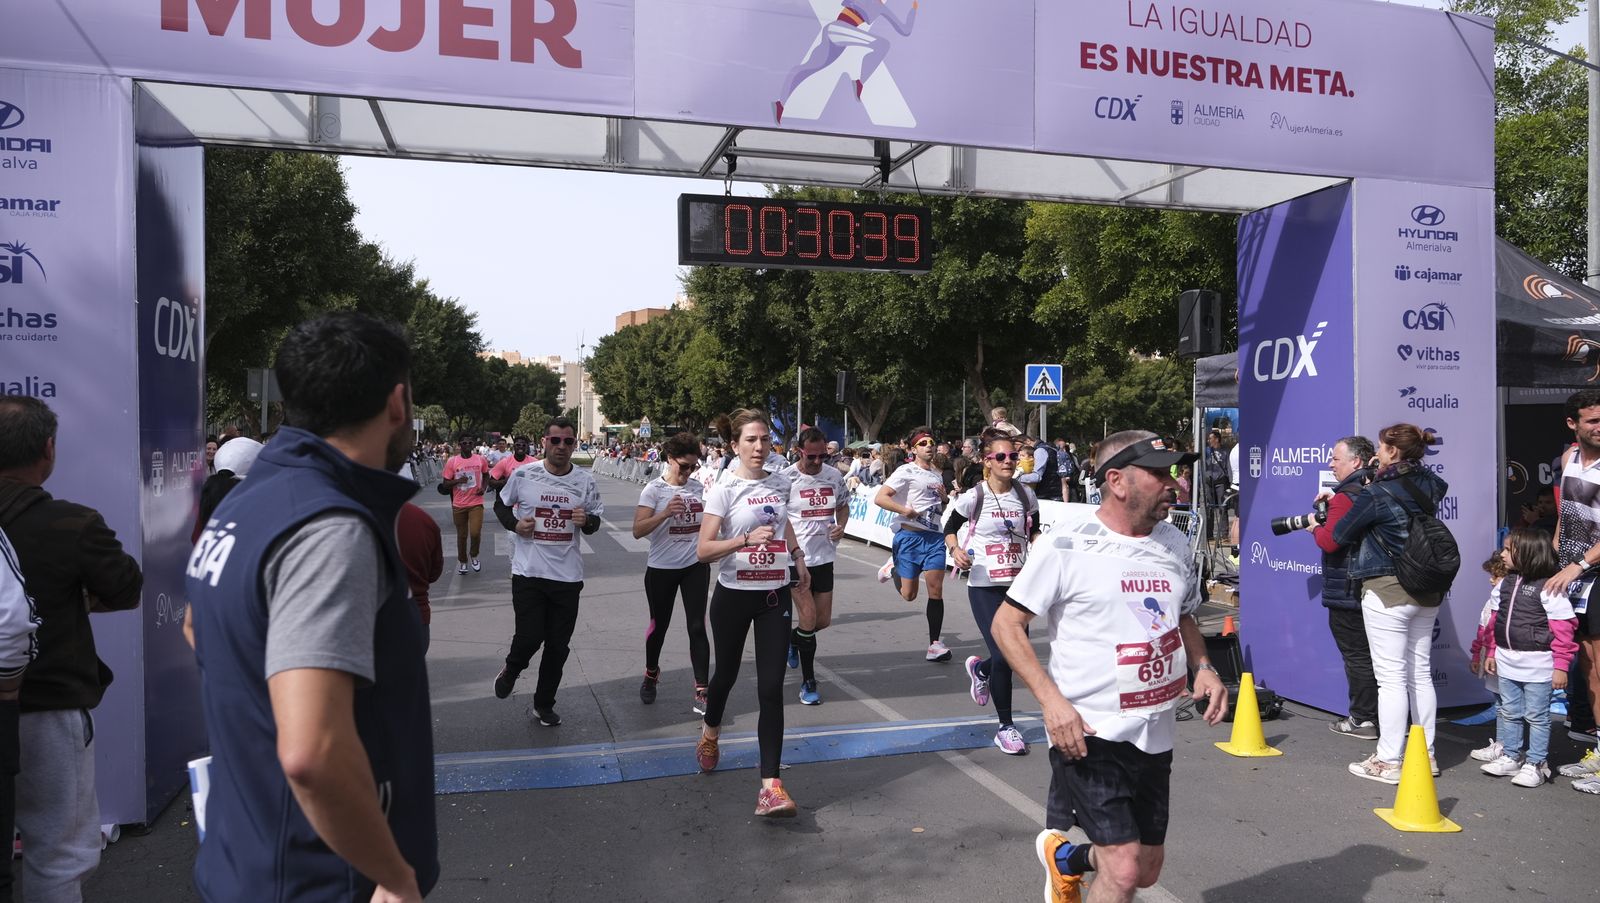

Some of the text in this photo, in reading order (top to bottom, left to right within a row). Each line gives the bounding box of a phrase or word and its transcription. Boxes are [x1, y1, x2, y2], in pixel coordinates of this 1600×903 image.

[1128, 0, 1312, 48] LA IGUALDAD
[1080, 42, 1355, 98] ES NUESTRA META.
[1094, 95, 1143, 121] CDX
[1194, 103, 1245, 120] ALMERÍA
[1193, 117, 1220, 127] CIUDAD
[725, 204, 920, 263] 00:30:39
[1398, 228, 1458, 242] HYUNDAI
[1406, 241, 1452, 253] Almerialva
[1414, 267, 1462, 283] cajamar
[155, 297, 199, 362] CDX
[15, 333, 58, 341] cuidarte
[1253, 321, 1328, 382] CDX
[1416, 346, 1460, 361] vithas
[1407, 393, 1459, 412] aqualia
[1272, 465, 1303, 476] CIUDAD
[540, 494, 570, 504] MUJER
[747, 495, 780, 506] MUJER
[809, 496, 828, 506] 830
[991, 510, 1021, 519] MUJER
[543, 519, 567, 529] 694
[748, 552, 776, 565] 693
[997, 553, 1017, 565] 879
[1121, 579, 1172, 593] MUJER
[1138, 654, 1174, 682] 697
[1148, 676, 1170, 687] MANUEL
